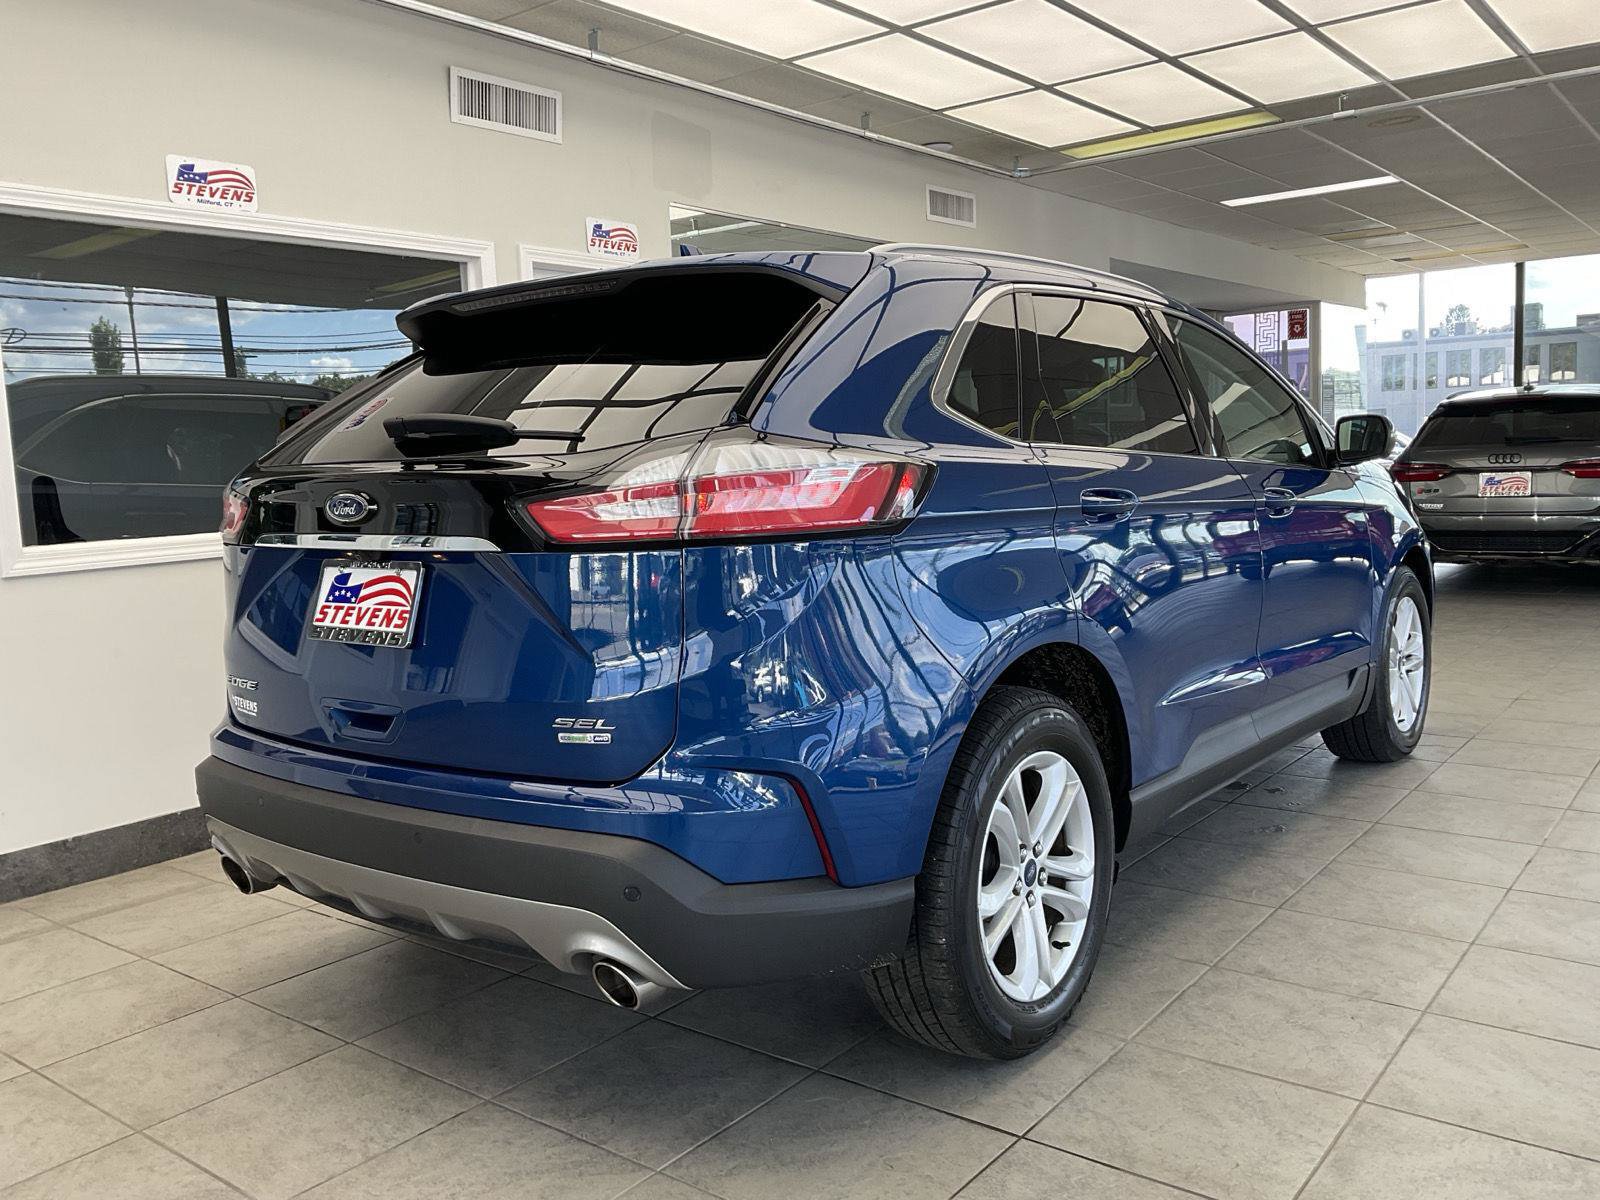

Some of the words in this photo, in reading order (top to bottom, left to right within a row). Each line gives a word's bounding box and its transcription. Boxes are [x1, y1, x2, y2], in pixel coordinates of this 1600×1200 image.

[172, 182, 255, 203] STEVENS
[197, 199, 222, 207] Milford,
[590, 238, 638, 253] STEVENS
[334, 500, 357, 515] Ford
[314, 604, 411, 629] STEVENS
[313, 626, 406, 646] STEVENS
[233, 695, 258, 713] STEVENS
[552, 717, 616, 729] SEL
